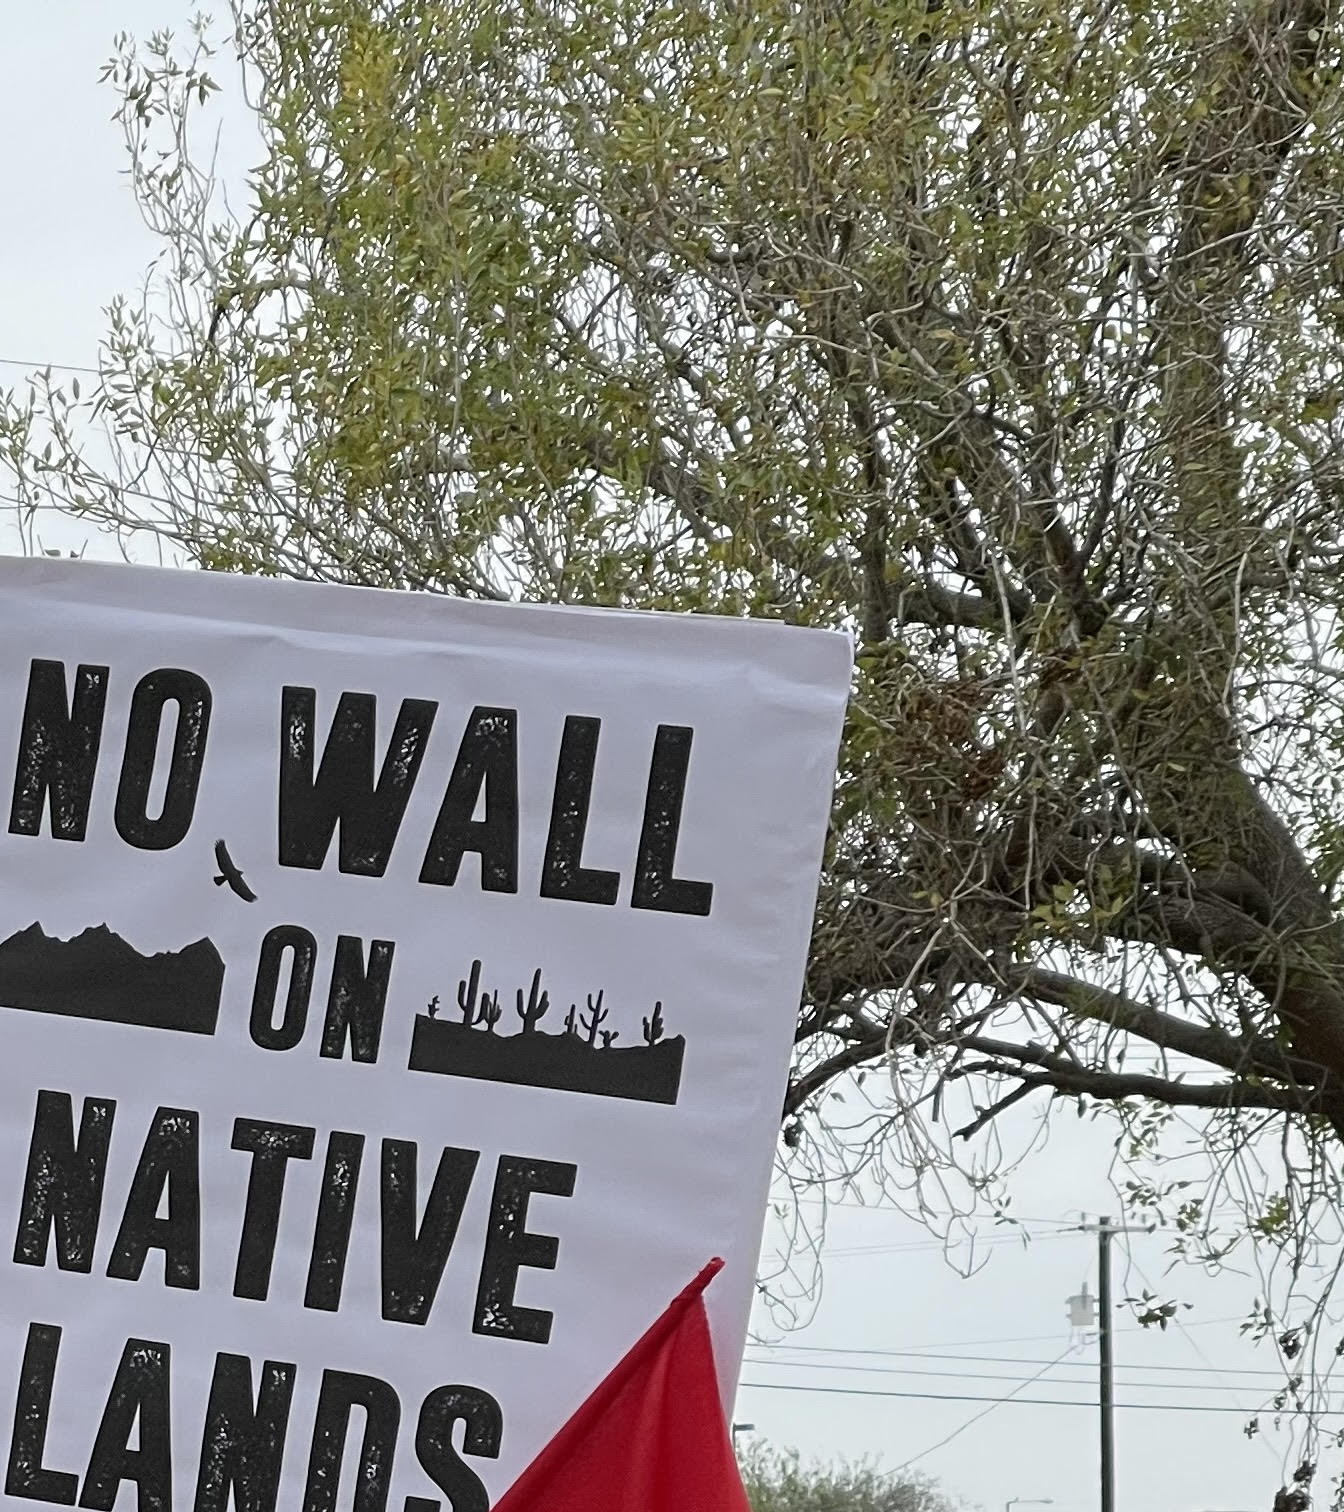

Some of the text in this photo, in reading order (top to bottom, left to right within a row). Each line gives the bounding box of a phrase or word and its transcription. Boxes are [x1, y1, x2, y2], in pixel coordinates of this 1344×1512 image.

[8, 658, 714, 917] NO WALL
[248, 924, 395, 1065] ON
[12, 1088, 579, 1346] NATIVE
